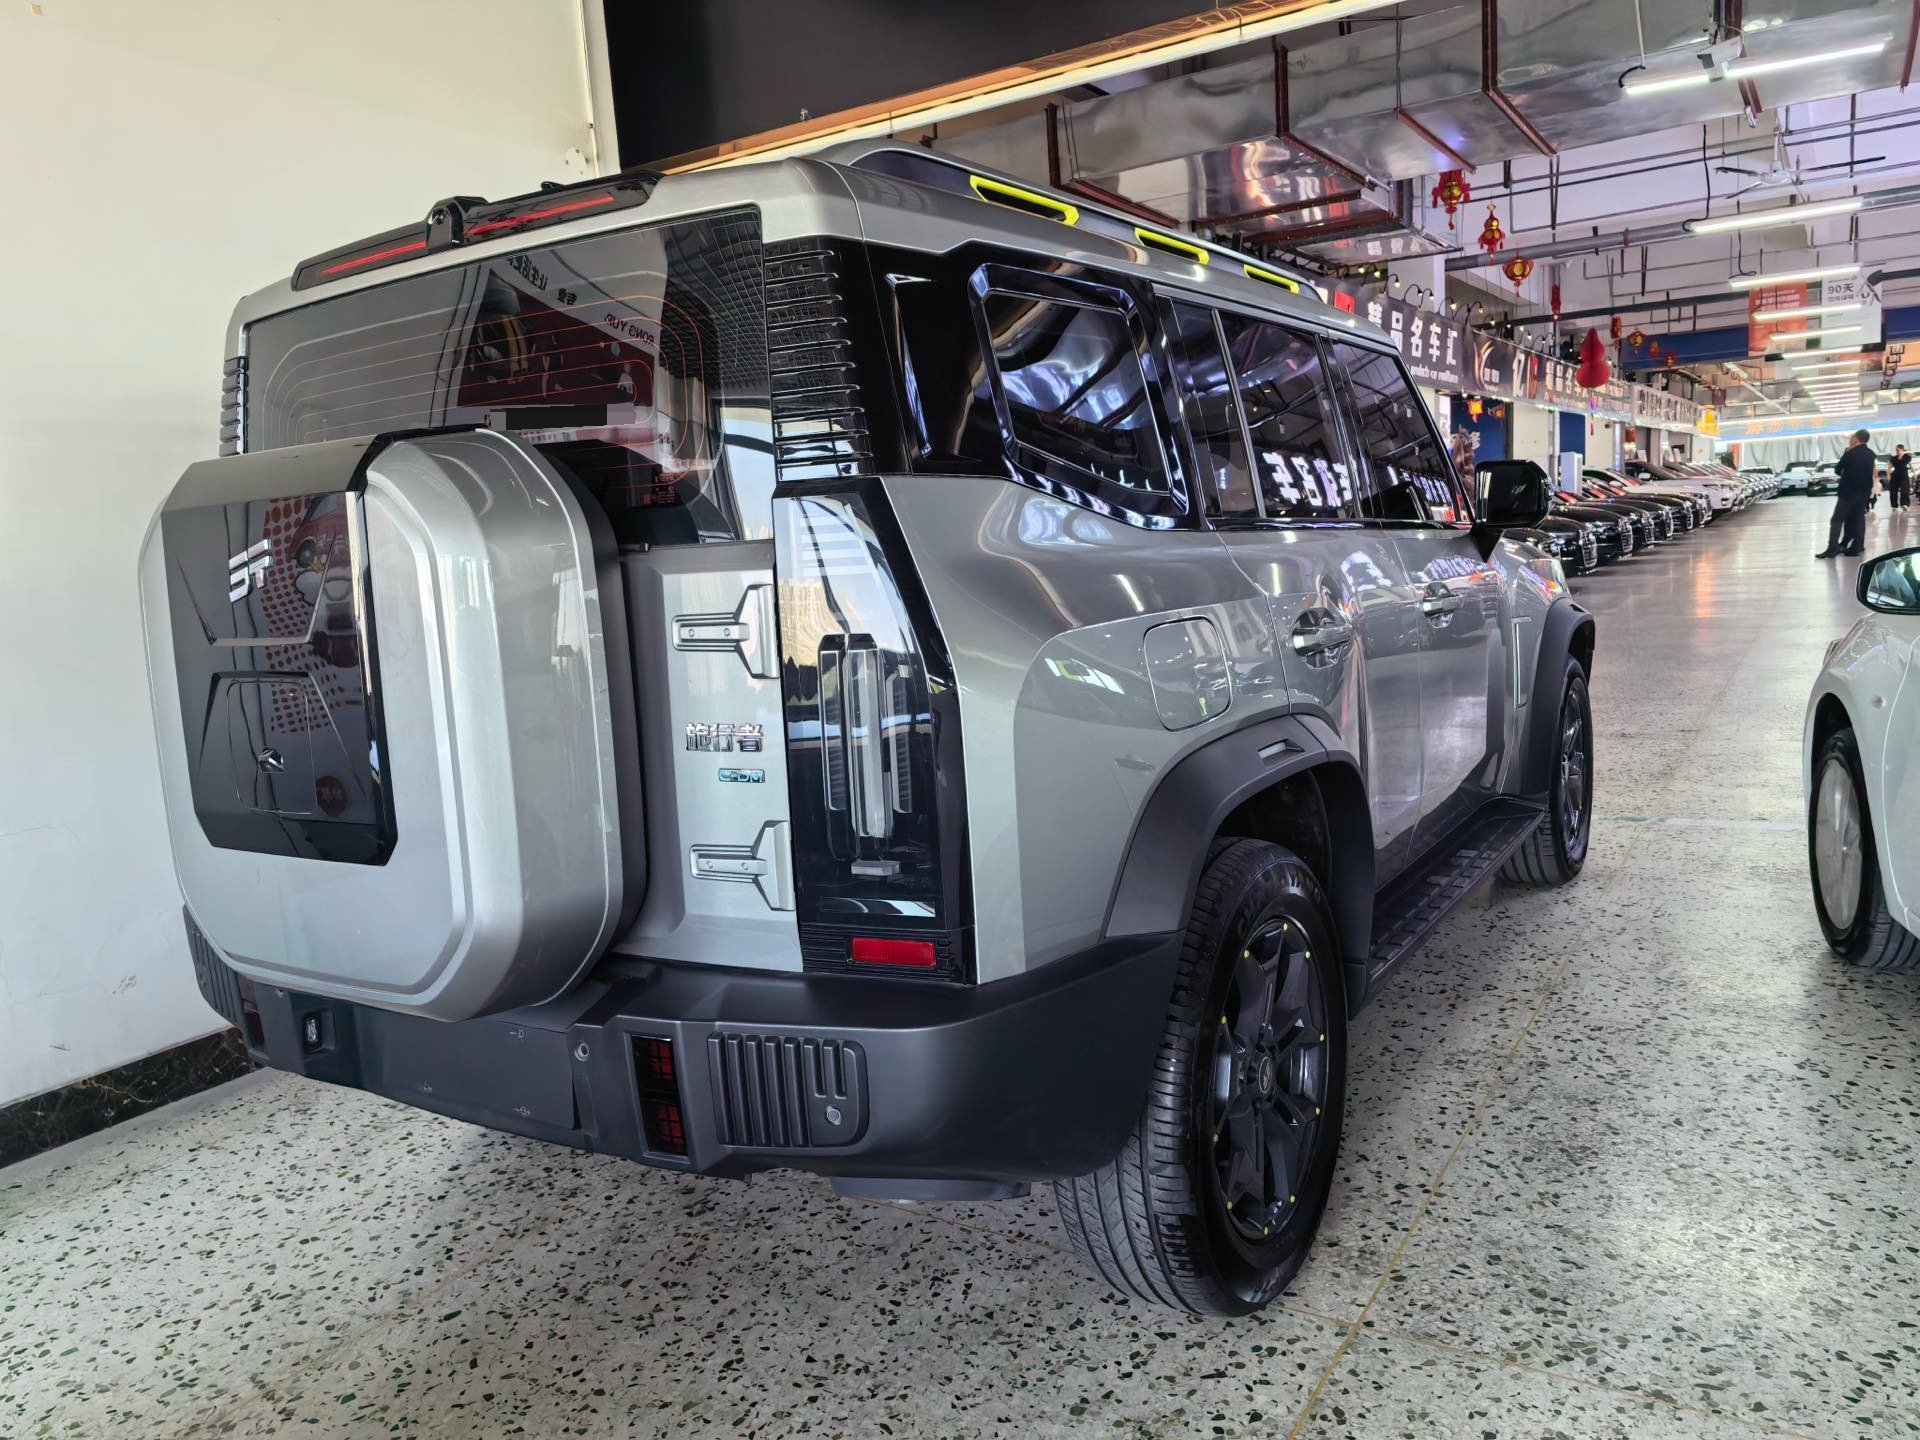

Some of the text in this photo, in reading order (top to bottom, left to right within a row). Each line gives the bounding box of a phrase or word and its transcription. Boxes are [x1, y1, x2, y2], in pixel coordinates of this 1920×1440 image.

[1827, 283, 1854, 294] 90天
[686, 722, 764, 752] 旅行者
